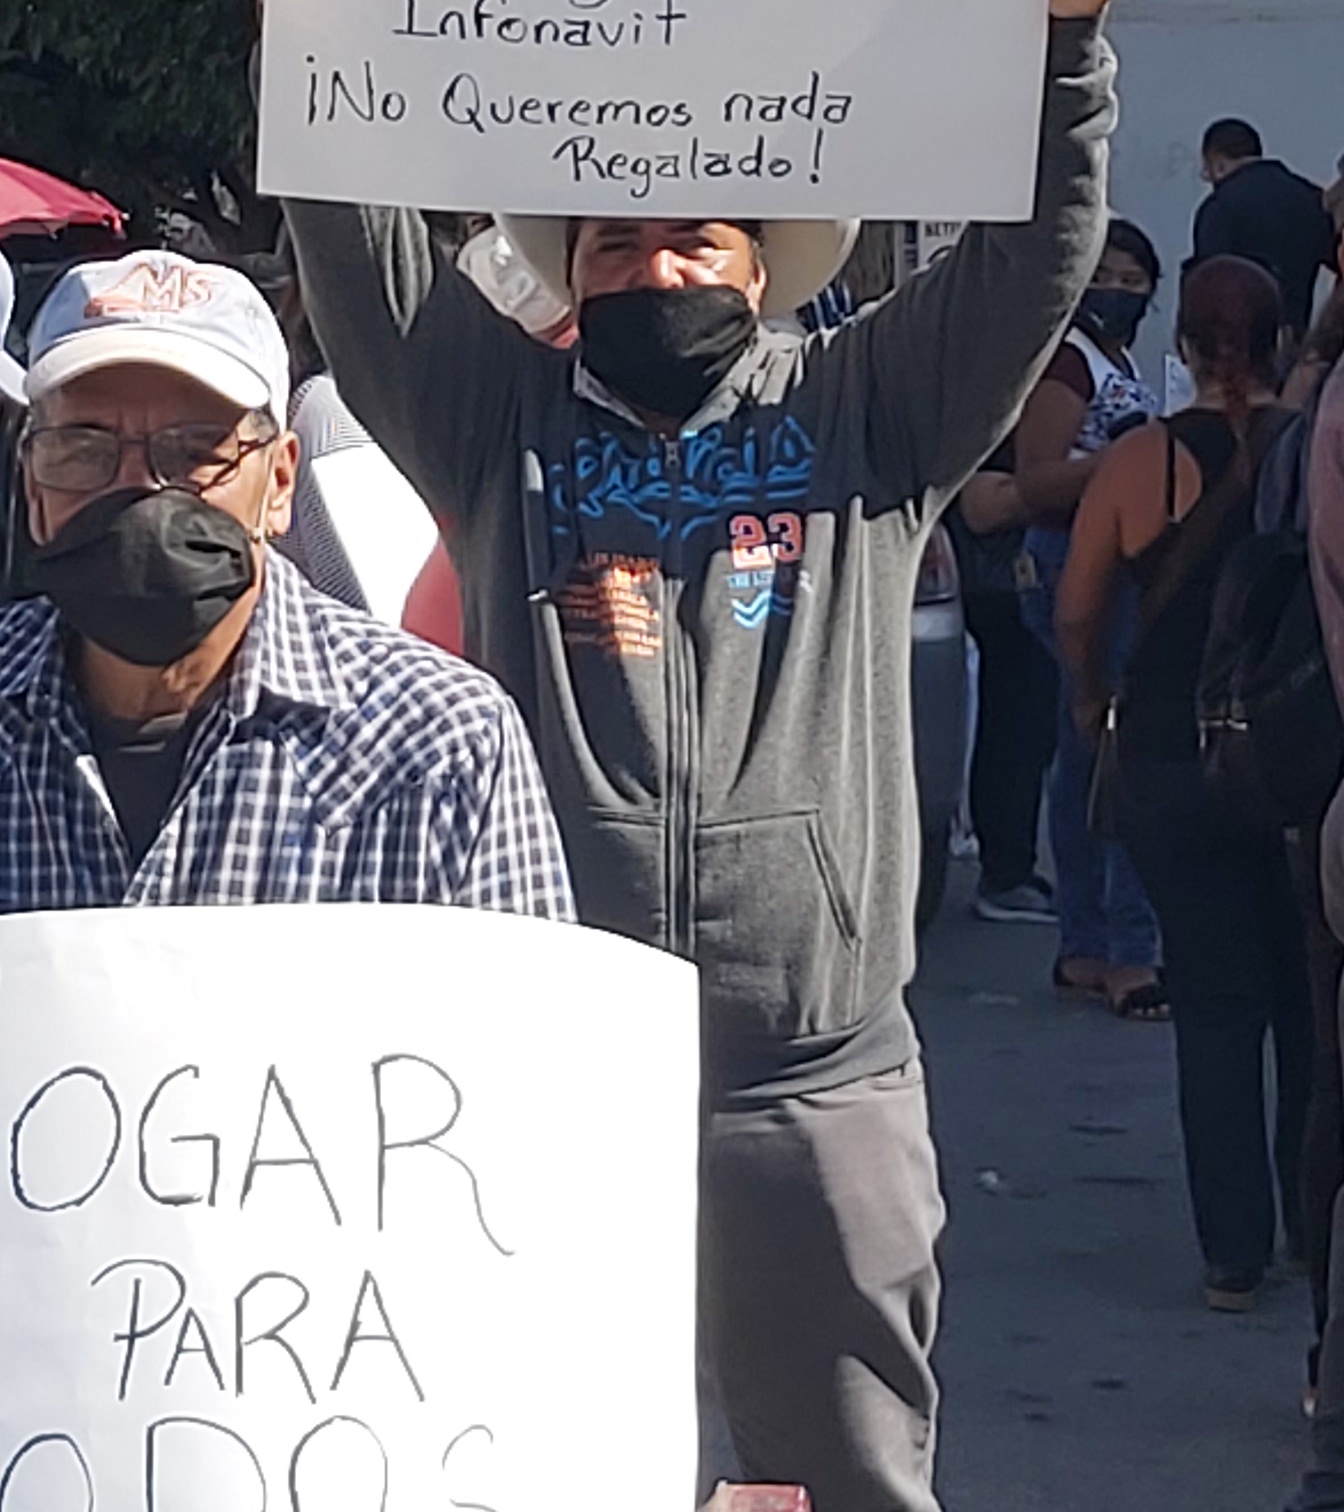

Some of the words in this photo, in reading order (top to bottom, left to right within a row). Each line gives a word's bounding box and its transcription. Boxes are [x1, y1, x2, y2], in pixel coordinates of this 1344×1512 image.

[441, 72, 694, 136] Queremos
[723, 70, 853, 131] nada
[730, 511, 804, 570] 23
[90, 1258, 426, 1405] PARA
